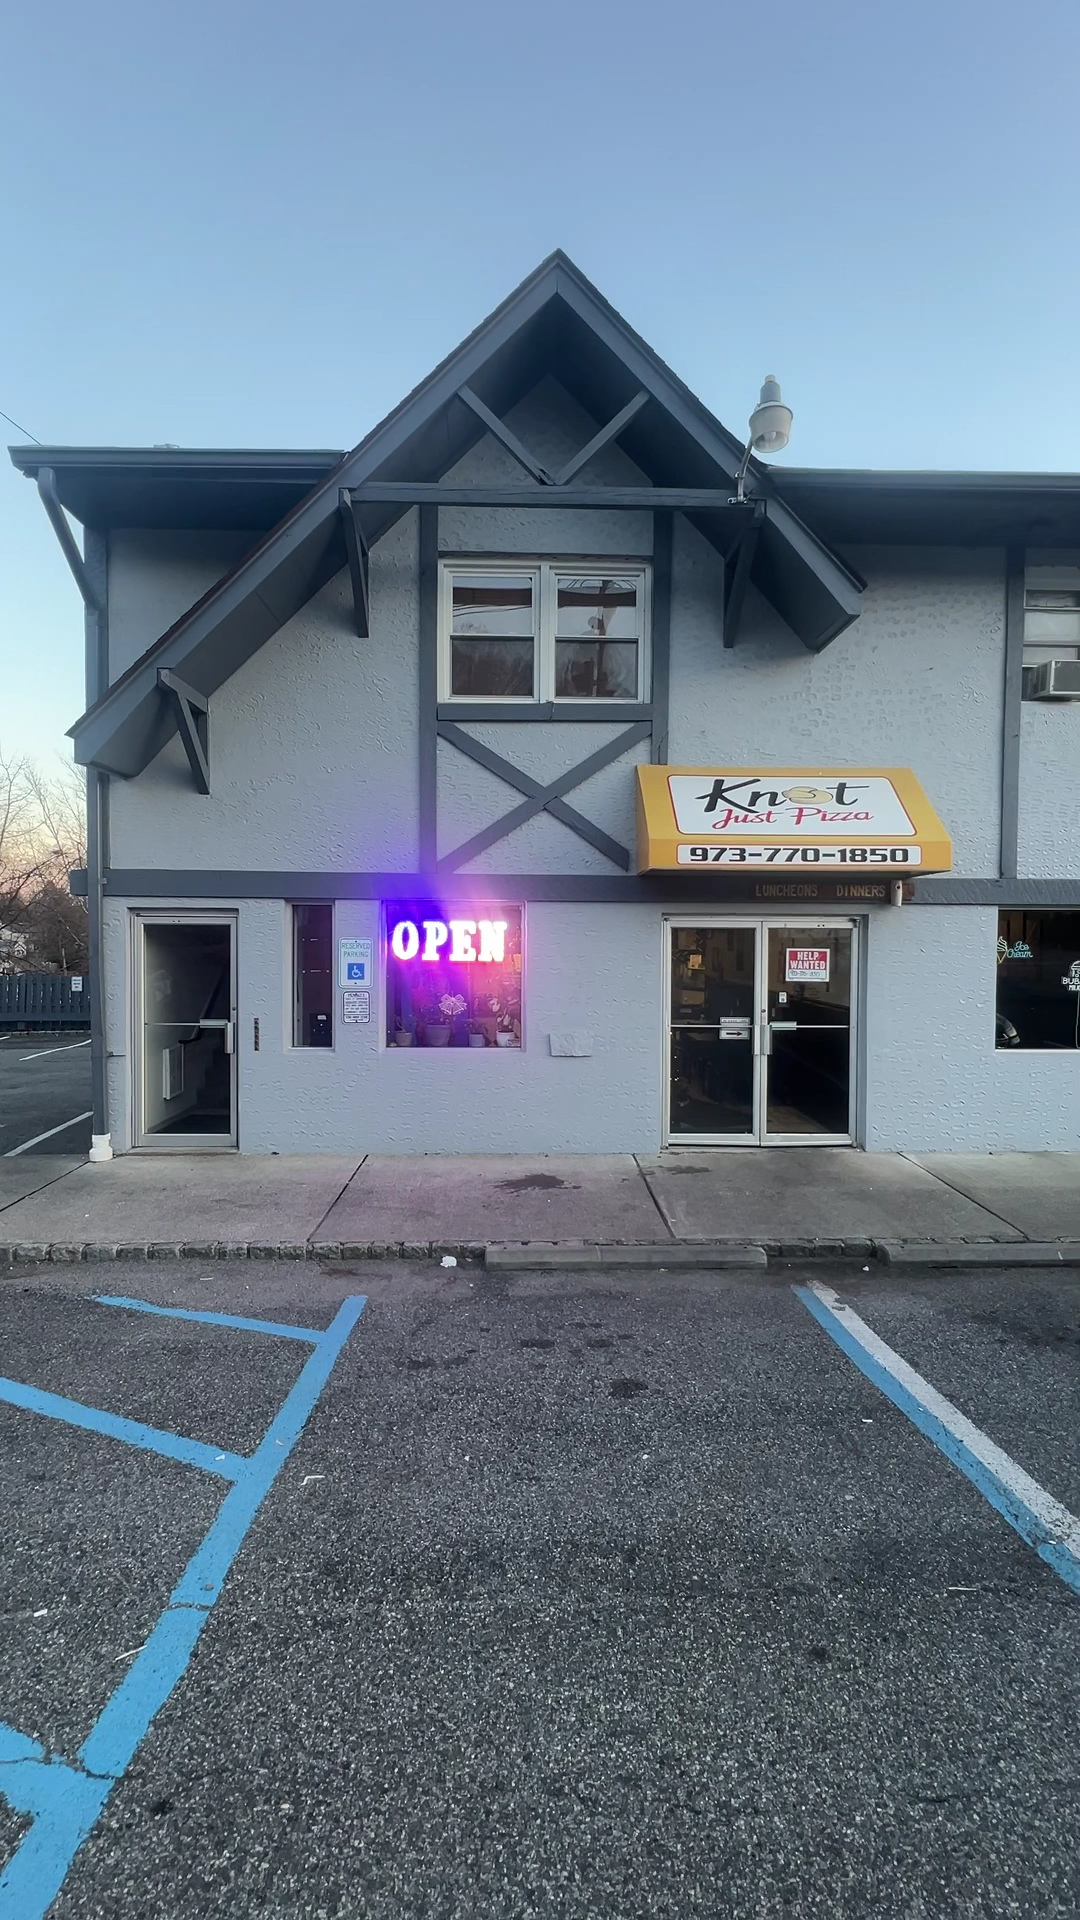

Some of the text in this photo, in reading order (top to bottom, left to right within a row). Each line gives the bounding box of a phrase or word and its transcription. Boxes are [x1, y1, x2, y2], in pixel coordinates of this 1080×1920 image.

[695, 779, 869, 813] Knot
[711, 807, 875, 829] Just Pizza
[690, 847, 909, 862] 973-770-1850
[755, 884, 886, 898] LUNCHEONS DINNERS
[341, 942, 370, 950] RESERVED
[392, 920, 508, 962] OPEN
[797, 951, 819, 960] HELP
[1006, 948, 1034, 958] Cream
[790, 960, 826, 970] WANTED
